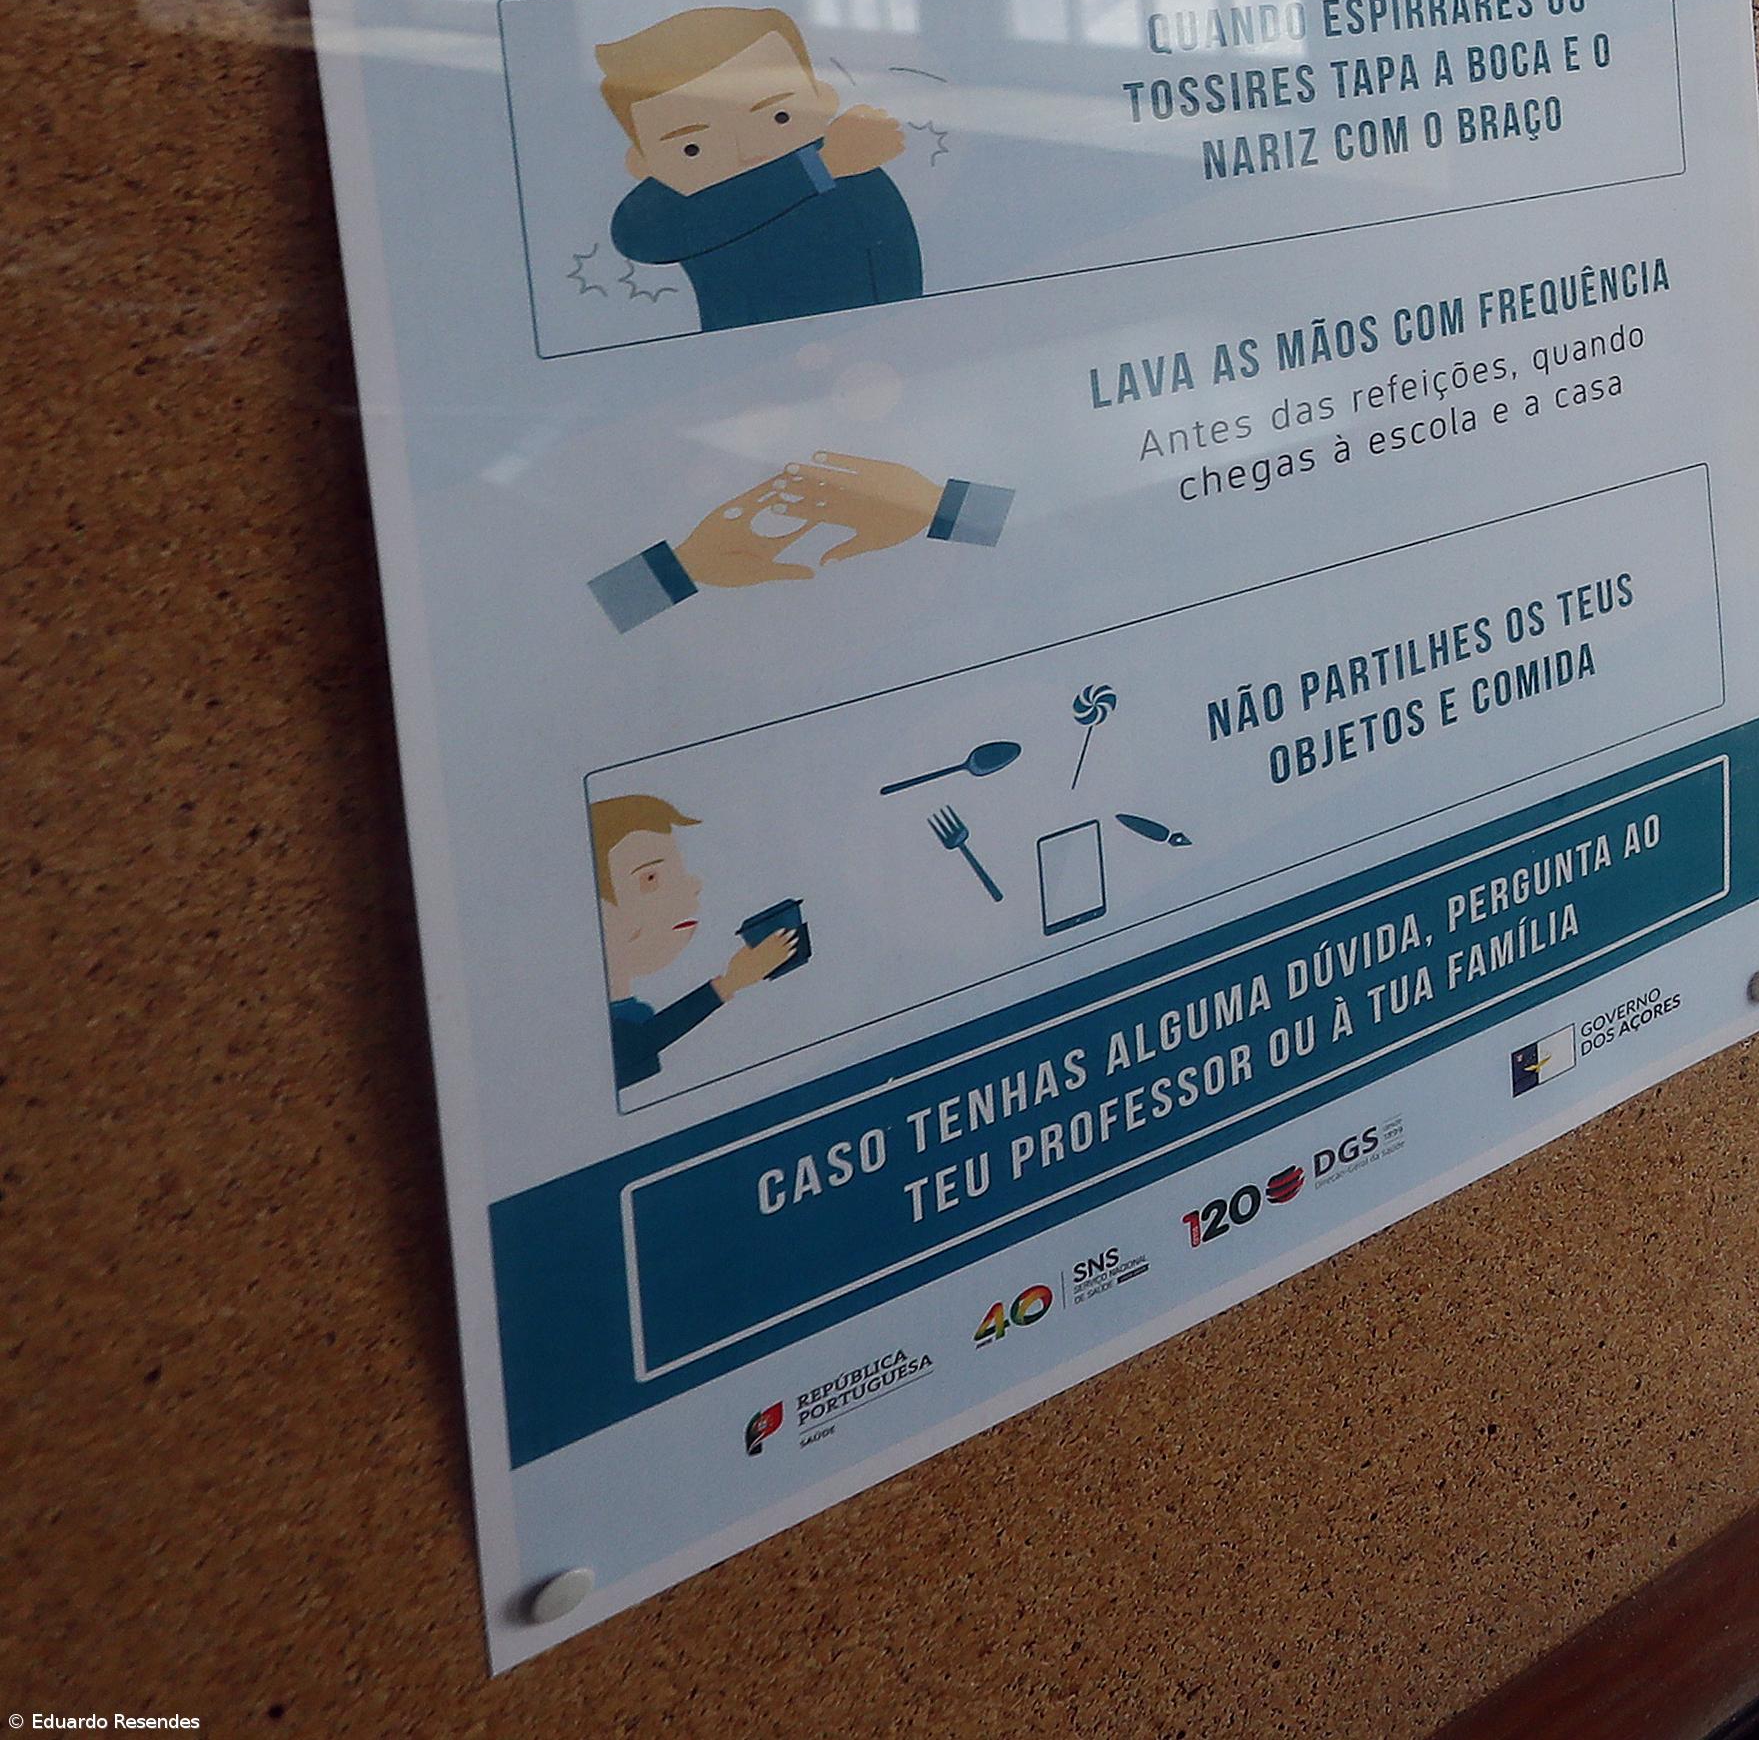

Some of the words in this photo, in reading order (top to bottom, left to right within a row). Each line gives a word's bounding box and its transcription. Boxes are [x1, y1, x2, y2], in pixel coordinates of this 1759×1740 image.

[1147, 1, 1307, 55] QUANDO
[1122, 64, 1315, 123] TOSSIRES
[1330, 56, 1420, 98] TAPA
[1434, 49, 1454, 88] A
[1469, 39, 1552, 84] BOCA
[1564, 35, 1581, 72] E
[1593, 32, 1611, 68] O
[1202, 127, 1319, 180] NARIZ
[1334, 115, 1410, 162] COM
[1424, 111, 1443, 149] O
[1457, 95, 1563, 145] BRAÇO
[1089, 350, 1194, 410] LAVA
[1212, 337, 1260, 385] AS
[1276, 313, 1379, 371] MÃOS
[1393, 297, 1465, 347] COM
[1478, 256, 1672, 329] FREQUÊNCIA
[1139, 408, 1253, 461] Antes
[1270, 394, 1335, 432] das
[1352, 354, 1518, 414] refeições,
[1532, 322, 1645, 377] quando
[1178, 443, 1317, 501] chegas
[1333, 433, 1353, 464] à
[1368, 407, 1478, 456] escola
[1492, 400, 1510, 425] e
[1523, 391, 1541, 416] a
[1553, 374, 1624, 411] casa
[1206, 681, 1285, 742] NÃO
[1299, 616, 1493, 712] PARTILHES
[1505, 600, 1546, 644] OS
[1556, 572, 1634, 626] TEUS
[1269, 698, 1425, 785] OBJETOS
[1440, 686, 1458, 727] E
[1472, 642, 1597, 715] COMIDA
[757, 1128, 887, 1216] CASO
[906, 1048, 1087, 1153] TENHAS
[1106, 974, 1271, 1076] ALGUMA
[1286, 912, 1434, 1002] DÚVIDA,
[1447, 833, 1612, 934] PERGUNTA
[1623, 813, 1662, 860] AO
[1580, 1029, 1615, 1056] DOS
[1618, 993, 1682, 1037] AÇORES
[1581, 987, 1662, 1037] GOVERNO
[904, 1152, 991, 1223] TEU
[1011, 1043, 1253, 1180] PROFESSOR
[1268, 1016, 1315, 1068] OU
[1331, 996, 1354, 1042] À
[1367, 966, 1434, 1025] TUA
[1447, 903, 1580, 990] FAMÍLIA
[1313, 1126, 1379, 1178] DGS
[1073, 1247, 1120, 1284] SNS
[973, 1283, 1054, 1341] 40
[797, 1348, 908, 1411] REPÚBLICA
[797, 1354, 934, 1427] PORTUGUESA
[800, 1424, 836, 1450] SAÚDE
